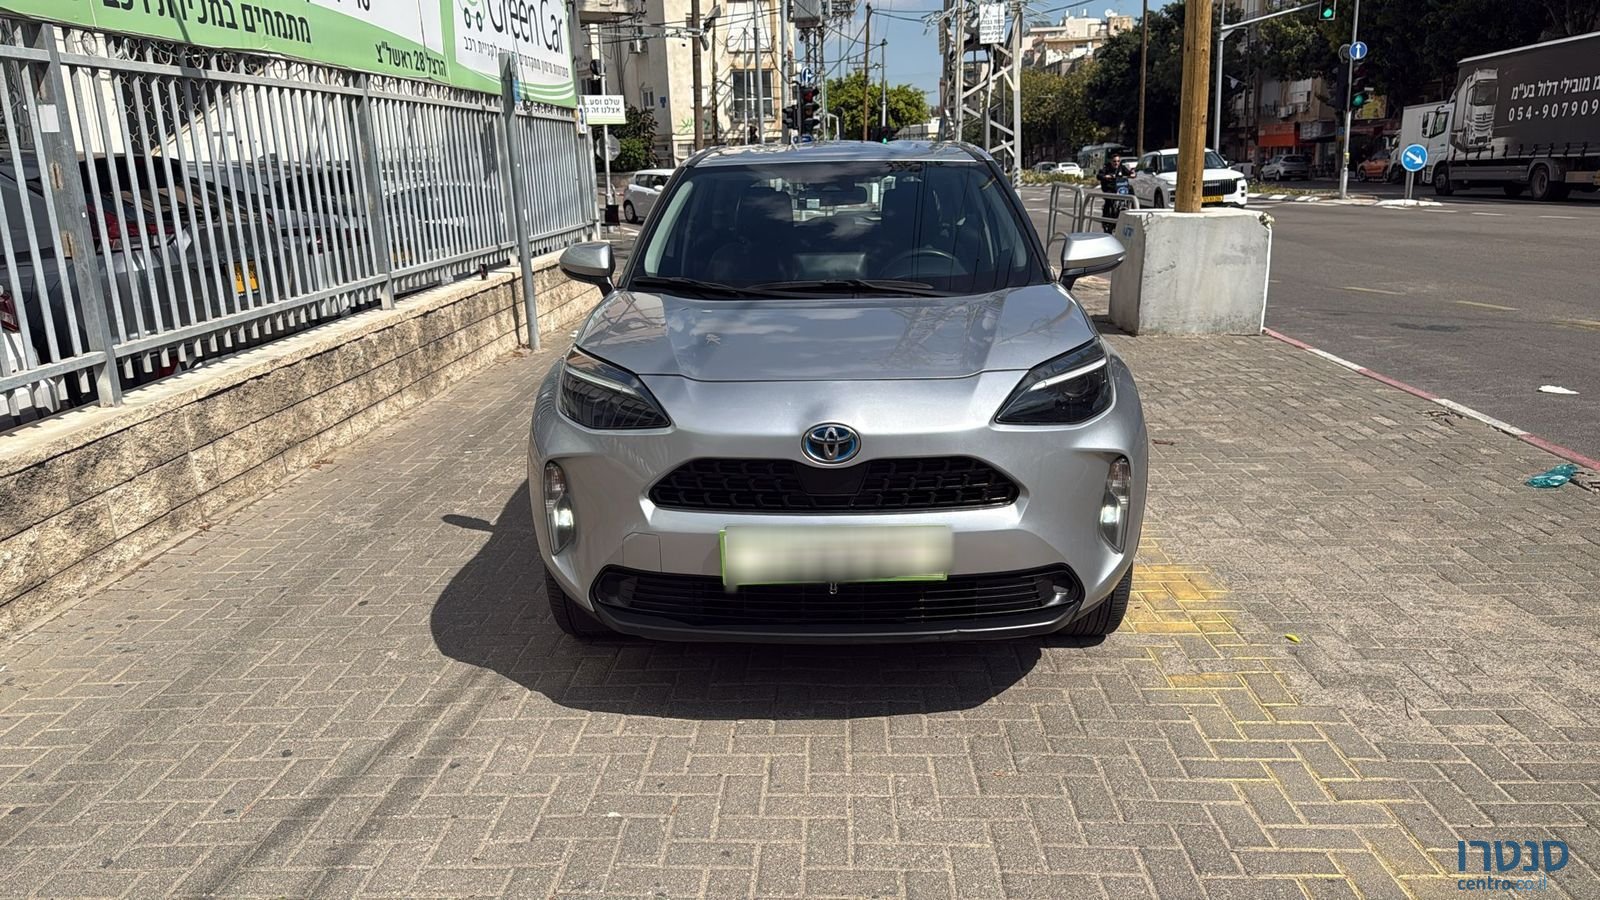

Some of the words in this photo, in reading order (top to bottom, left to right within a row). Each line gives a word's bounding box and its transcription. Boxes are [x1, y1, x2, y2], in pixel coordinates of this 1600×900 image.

[240, 3, 312, 43] מתמחים
[488, 0, 539, 46] Green
[540, 0, 563, 54] Car
[375, 41, 413, 70] ראשל"צ
[463, 36, 477, 53] רכב
[413, 50, 426, 72] 28
[425, 51, 447, 77] הרצל
[1511, 83, 1535, 100] בע"מ
[1538, 80, 1559, 97] דלול
[1560, 76, 1591, 94] מובילי
